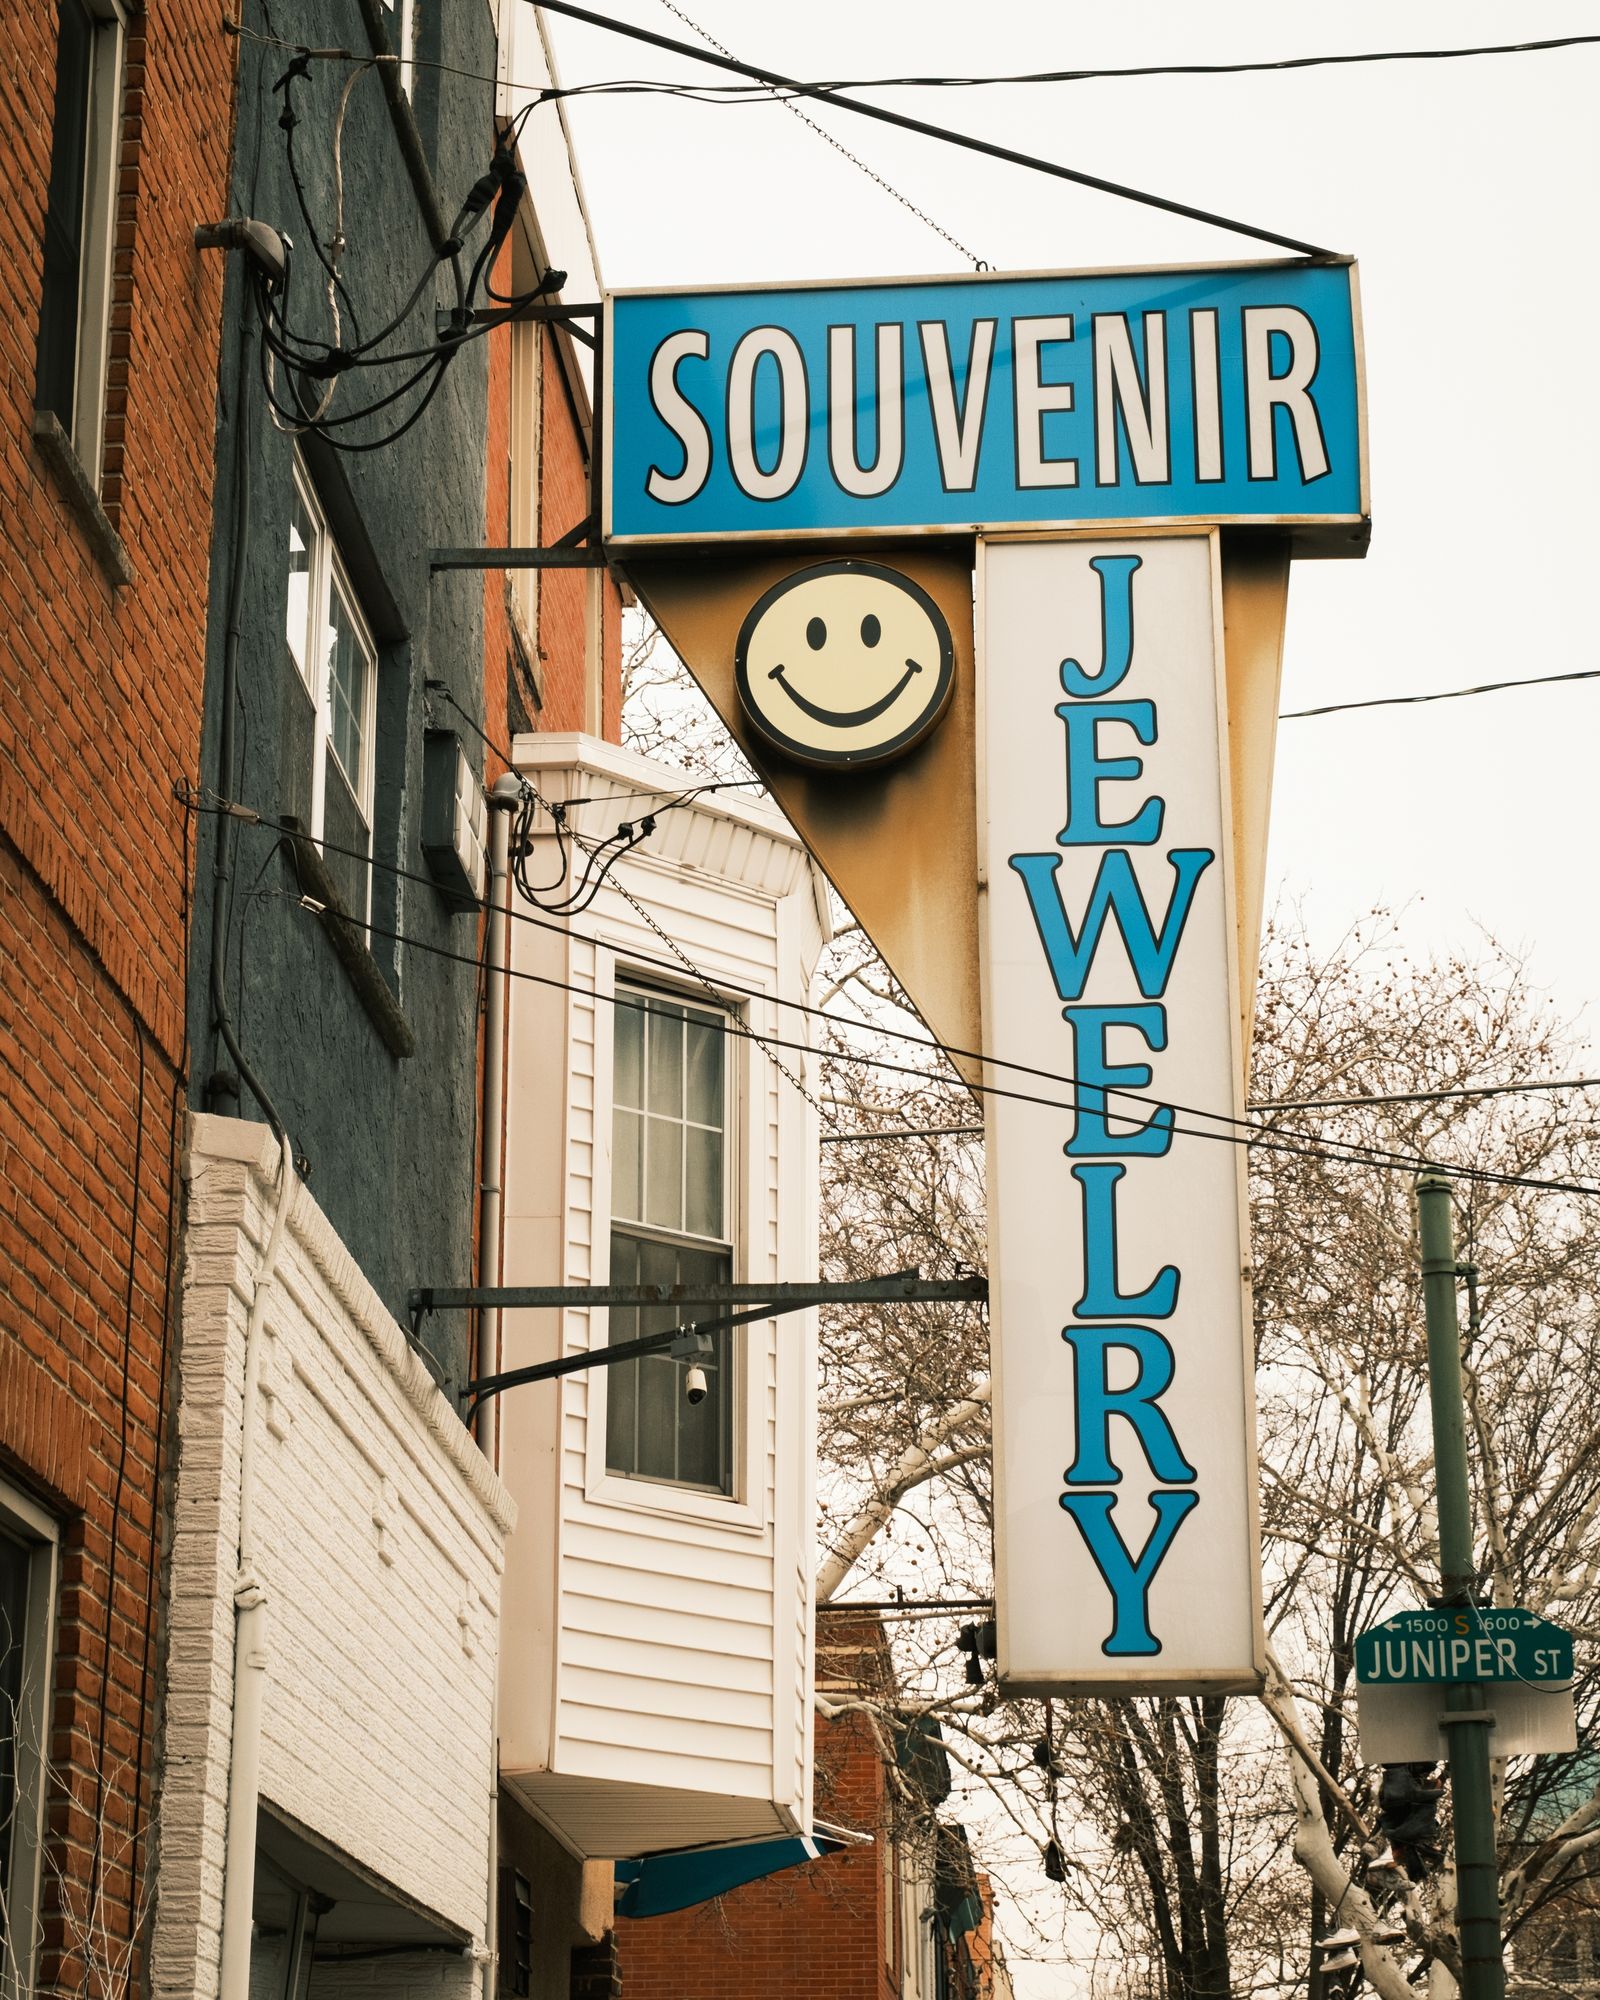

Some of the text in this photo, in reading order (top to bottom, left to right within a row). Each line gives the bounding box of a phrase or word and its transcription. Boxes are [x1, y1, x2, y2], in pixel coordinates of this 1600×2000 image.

[644, 304, 1331, 506] SOUVENIR
[1008, 554, 1214, 1657] JEWELRY
[1367, 1638, 1561, 1679] JUNIPER ST
[1406, 1615, 1520, 1636] 1500 S 1600
